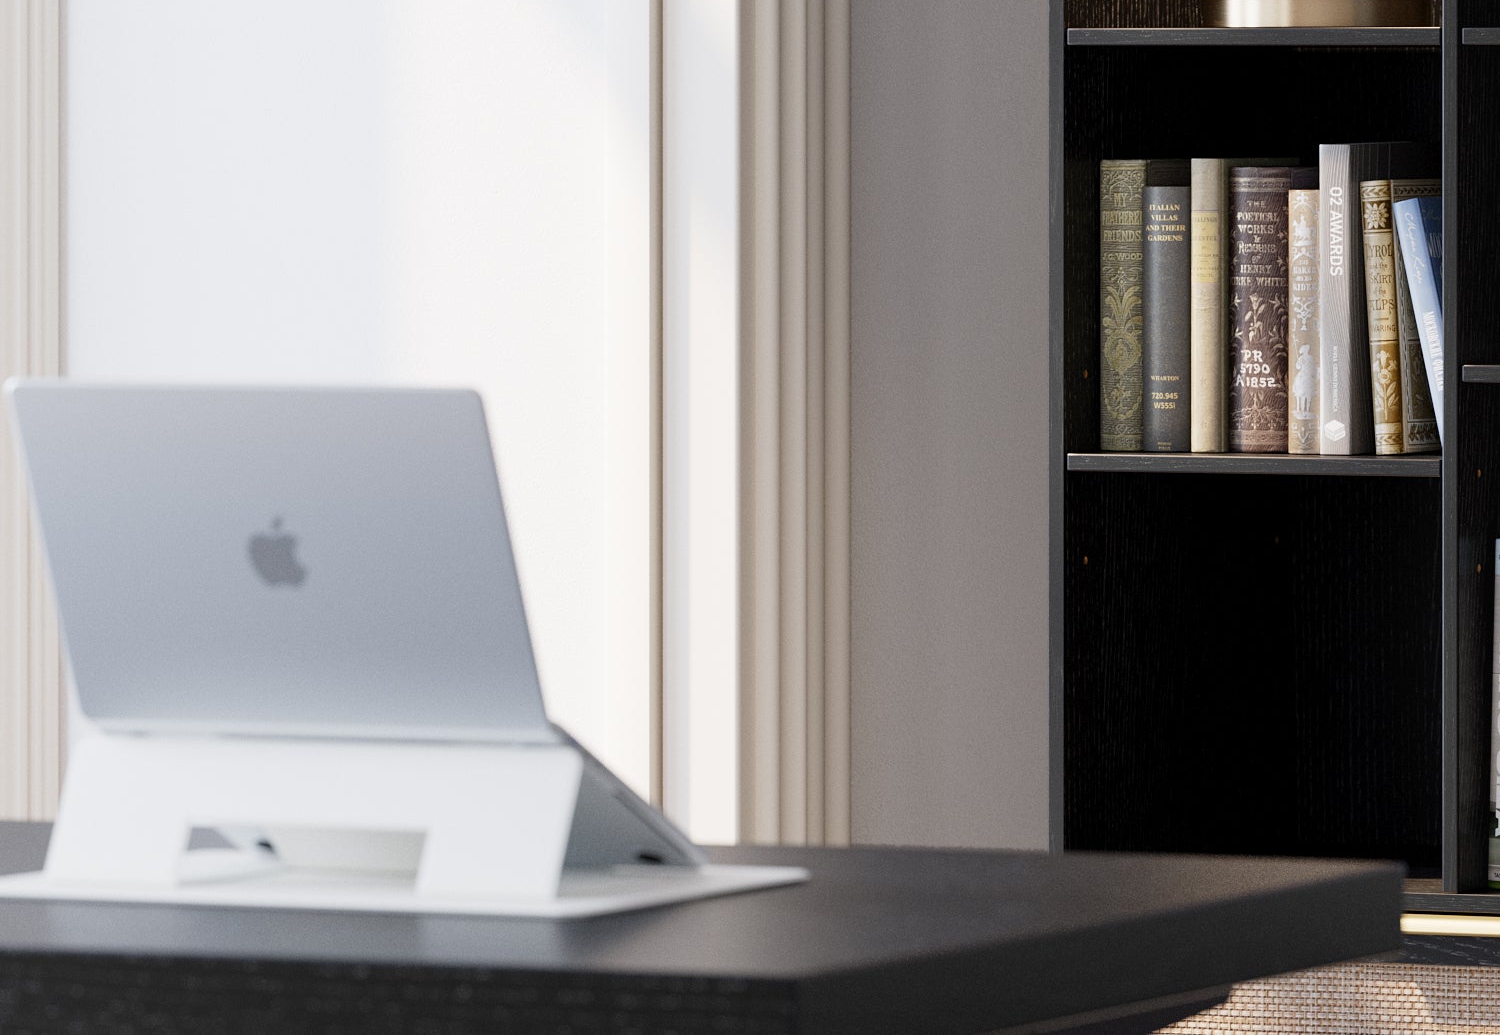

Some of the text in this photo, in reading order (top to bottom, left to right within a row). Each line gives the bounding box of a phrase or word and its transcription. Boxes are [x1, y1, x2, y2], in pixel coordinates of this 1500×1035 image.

[1113, 192, 1128, 207] MY
[1246, 200, 1266, 208] THE
[1149, 204, 1181, 212] ITALIAN
[1151, 214, 1178, 222] VILLAS
[1236, 211, 1280, 222] POETICAL
[1145, 224, 1186, 232] AND THEIR
[1237, 224, 1274, 234] WORKS
[1147, 234, 1183, 242] GARDENS
[1329, 211, 1343, 276] AWARDS
[1240, 264, 1273, 274] HENRY
[1240, 363, 1270, 374] 5790
